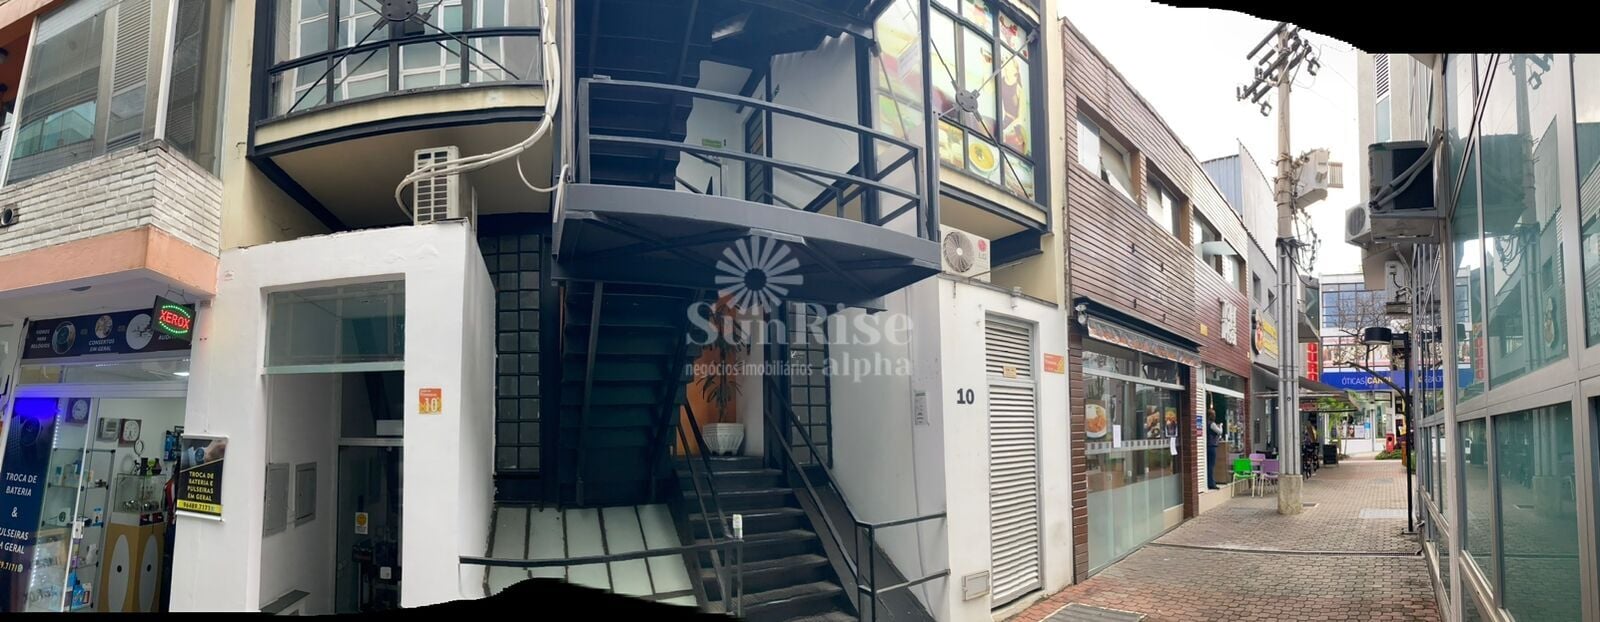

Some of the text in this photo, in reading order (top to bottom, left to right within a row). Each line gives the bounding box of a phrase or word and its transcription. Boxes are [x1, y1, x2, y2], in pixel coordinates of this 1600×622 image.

[158, 309, 191, 330] XEROX
[88, 337, 115, 347] CONSERTOS
[1341, 376, 1366, 386] ÓTICAS
[957, 388, 975, 405] 10
[6, 472, 38, 484] TROCA DE
[6, 486, 32, 497] BATERIA
[187, 486, 214, 494] PULSEIRAS
[11, 506, 18, 518] &
[4, 541, 25, 554] GERAL
